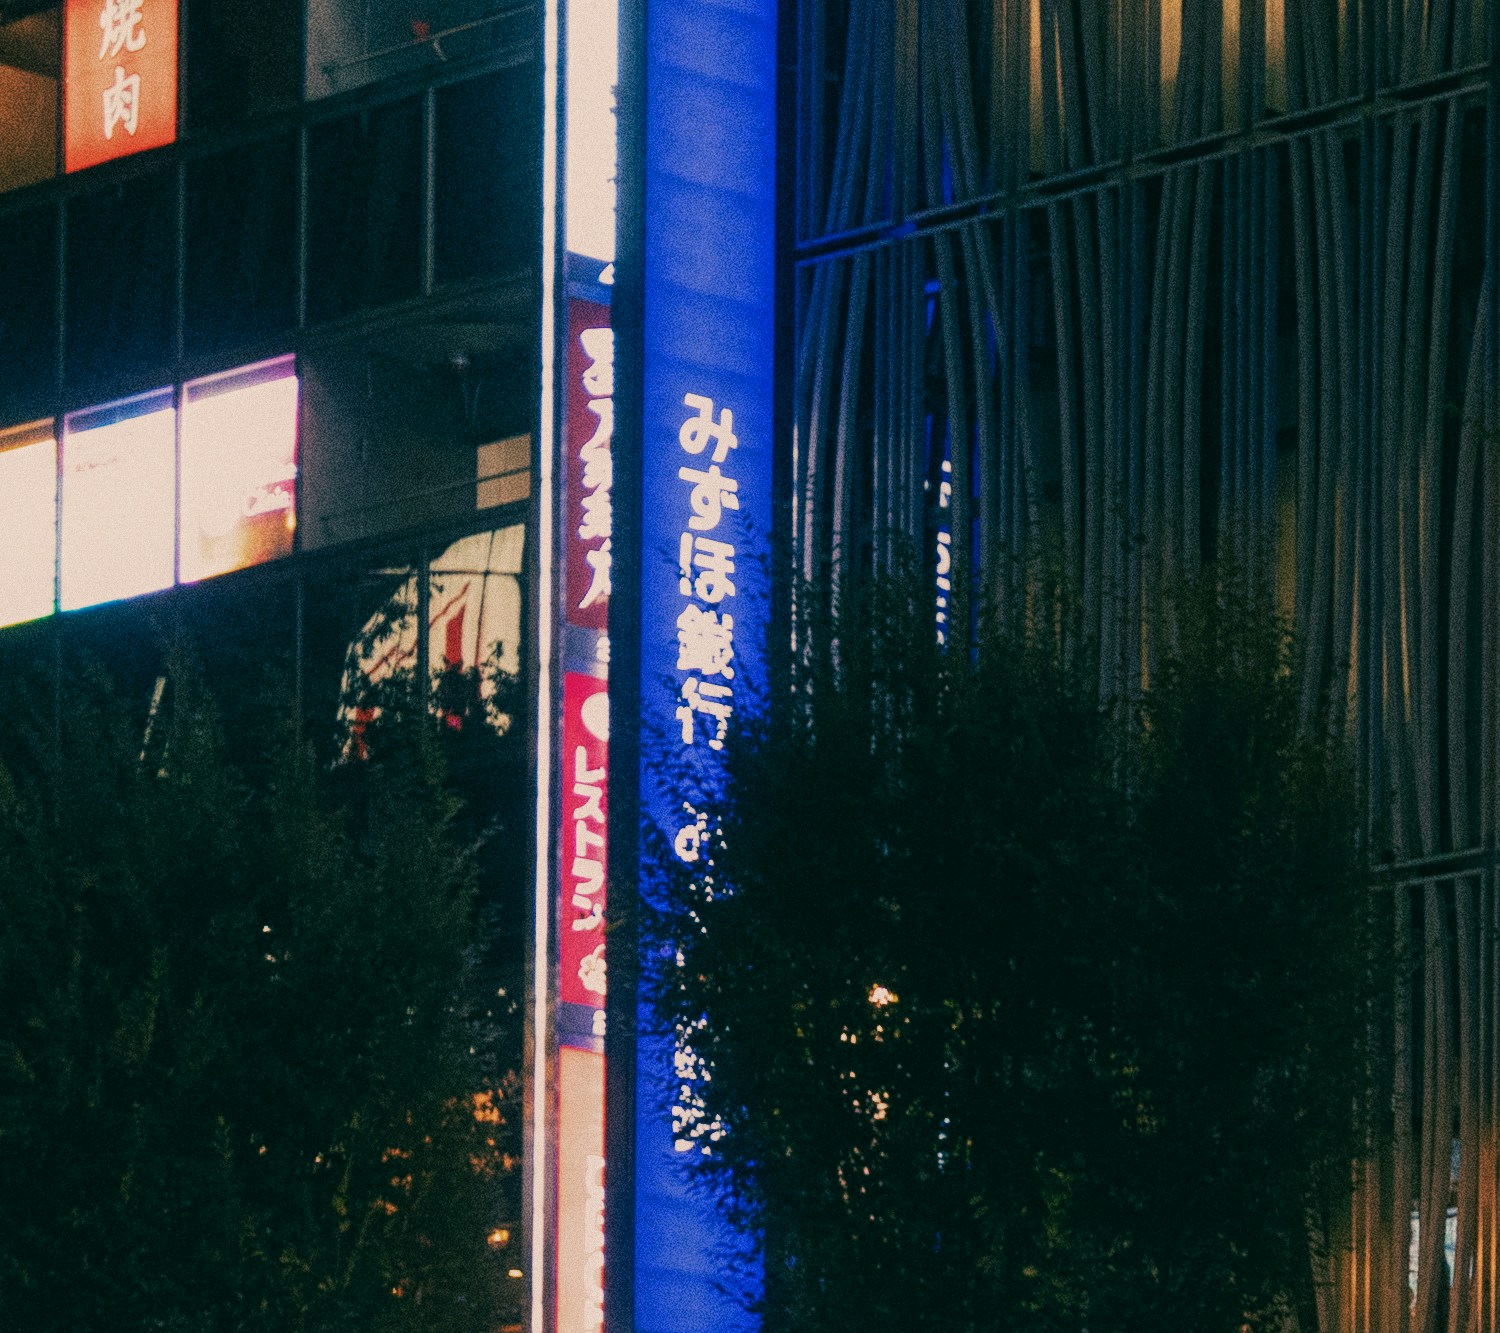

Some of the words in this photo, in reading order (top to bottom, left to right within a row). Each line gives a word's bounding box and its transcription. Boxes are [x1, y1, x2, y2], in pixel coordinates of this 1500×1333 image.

[99, 0, 147, 141] 焼肉
[676, 391, 740, 751] みずほ銀行
